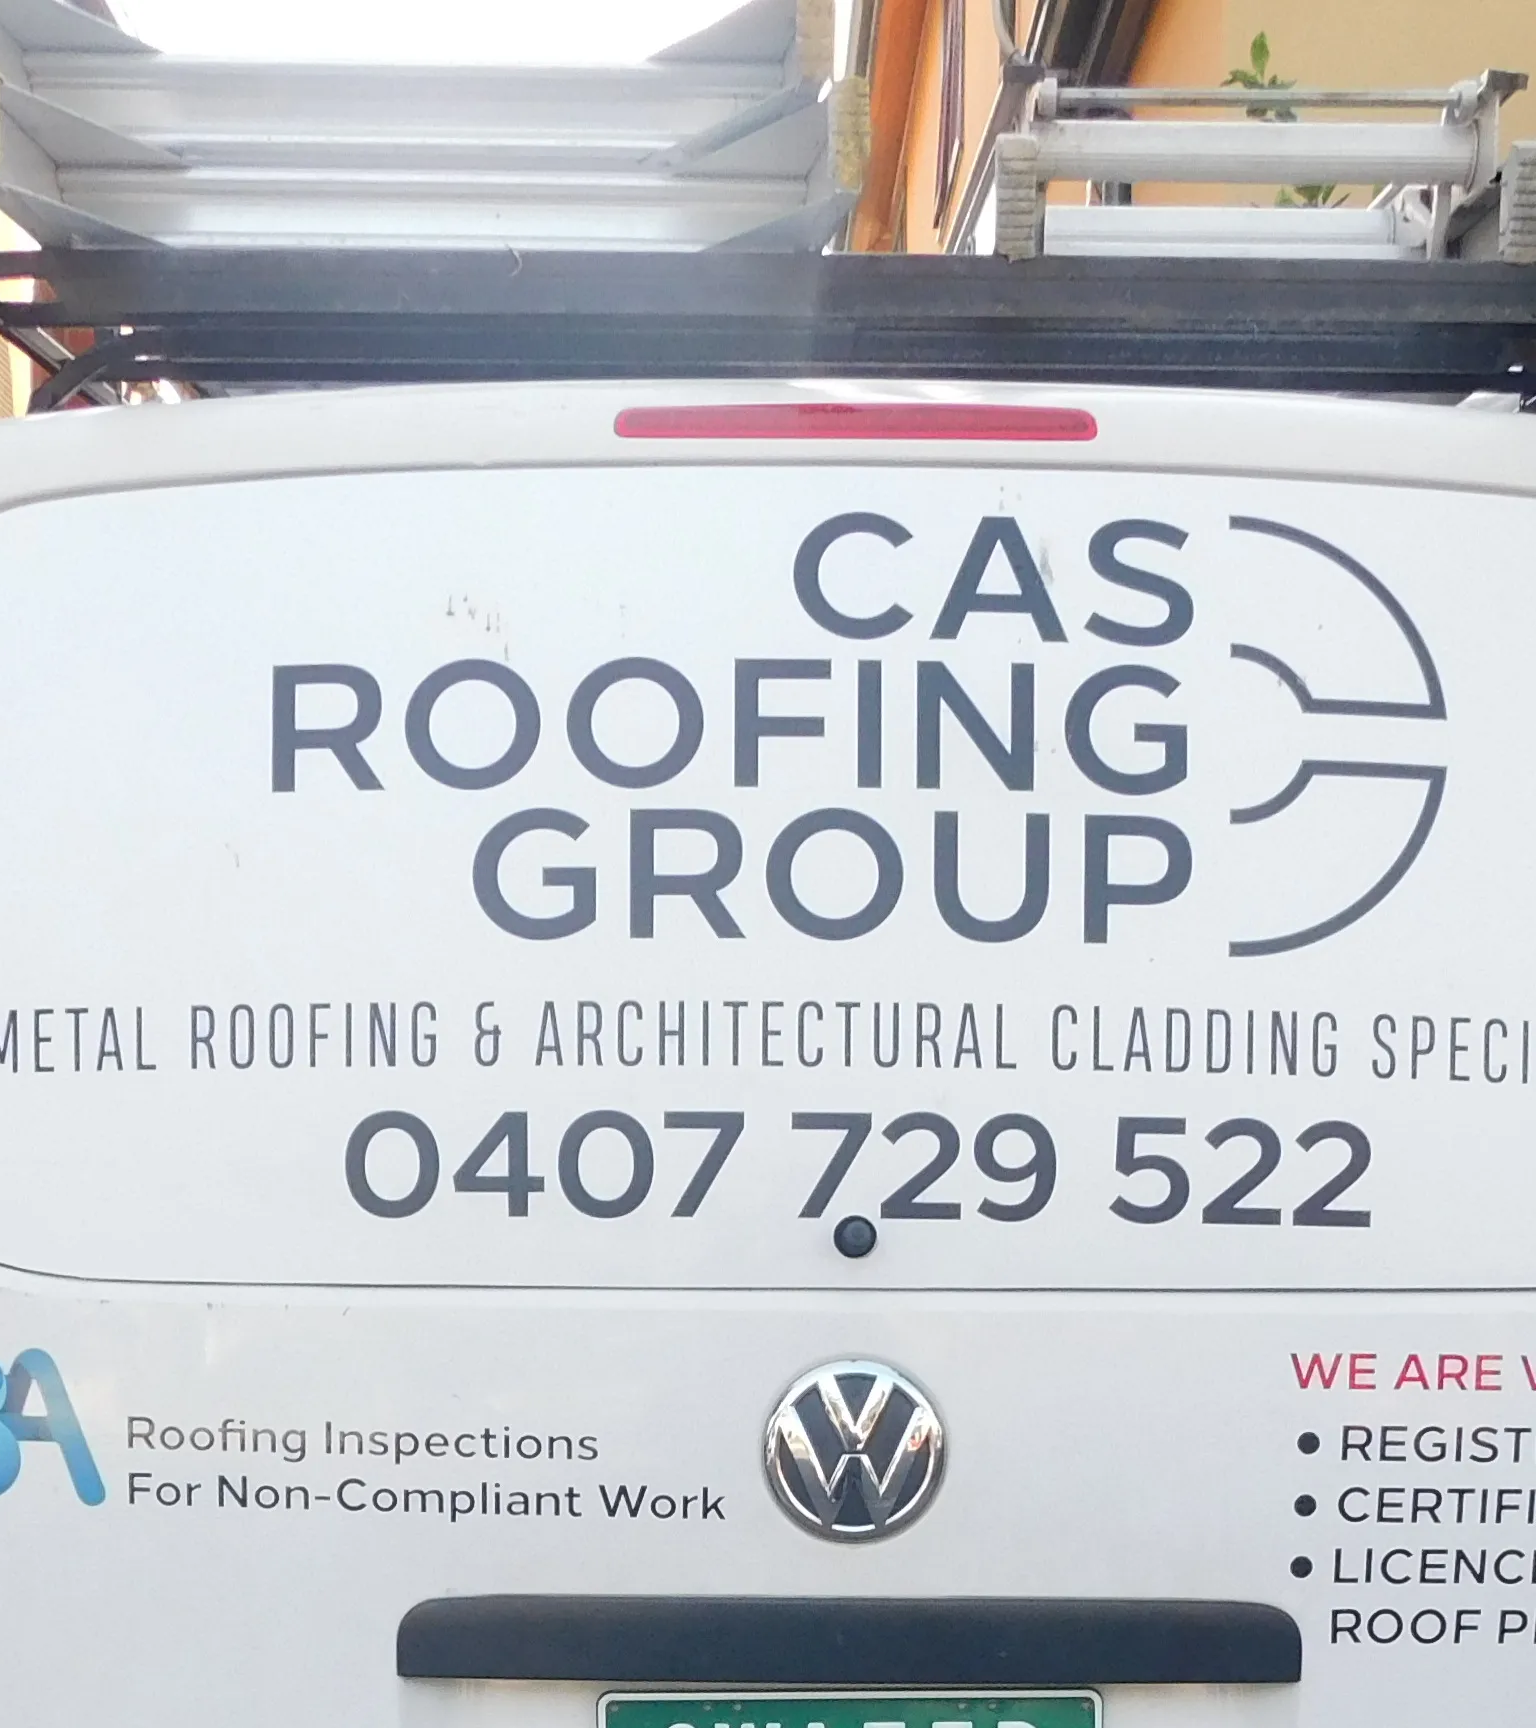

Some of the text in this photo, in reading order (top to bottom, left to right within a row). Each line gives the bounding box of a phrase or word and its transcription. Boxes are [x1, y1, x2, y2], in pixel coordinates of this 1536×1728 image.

[792, 511, 1195, 648] CAS
[270, 656, 1189, 796] ROOFING
[471, 807, 1194, 945] GROUP
[190, 1001, 438, 1070] ROOFING
[473, 1001, 503, 1068] &
[534, 1000, 1018, 1070] ARCHITECTURAL
[1050, 1004, 1339, 1078] CLADDING
[344, 1109, 1373, 1228] 0407 729 522
[1289, 1352, 1379, 1390] WE
[1392, 1353, 1504, 1391] ARE
[126, 1416, 600, 1465] Roofing Inspections
[127, 1472, 727, 1523] For Non-Compliant Work
[1329, 1608, 1483, 1645] ROOF
